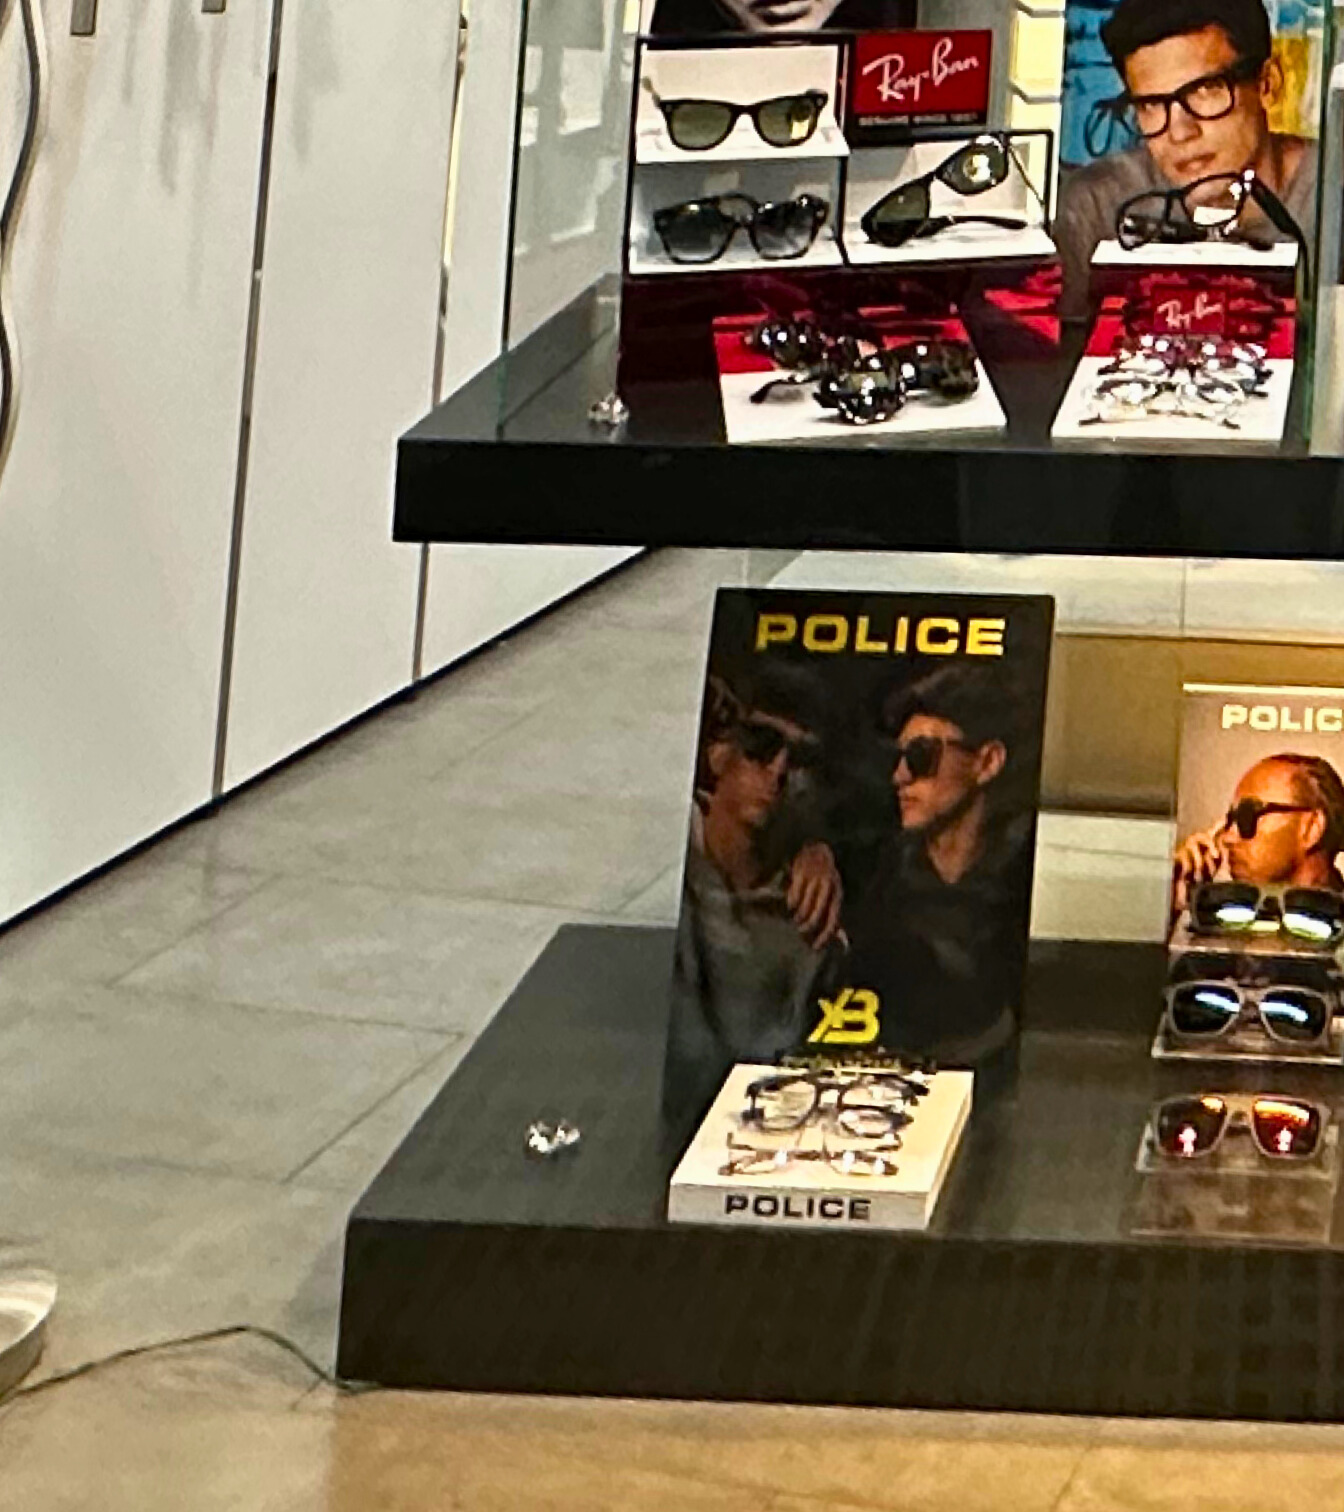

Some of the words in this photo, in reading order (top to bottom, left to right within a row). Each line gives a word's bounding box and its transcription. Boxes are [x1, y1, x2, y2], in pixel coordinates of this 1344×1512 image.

[862, 36, 979, 102] Ray-Ban
[755, 614, 1006, 656] POLICE
[724, 1193, 872, 1221] POLICE
